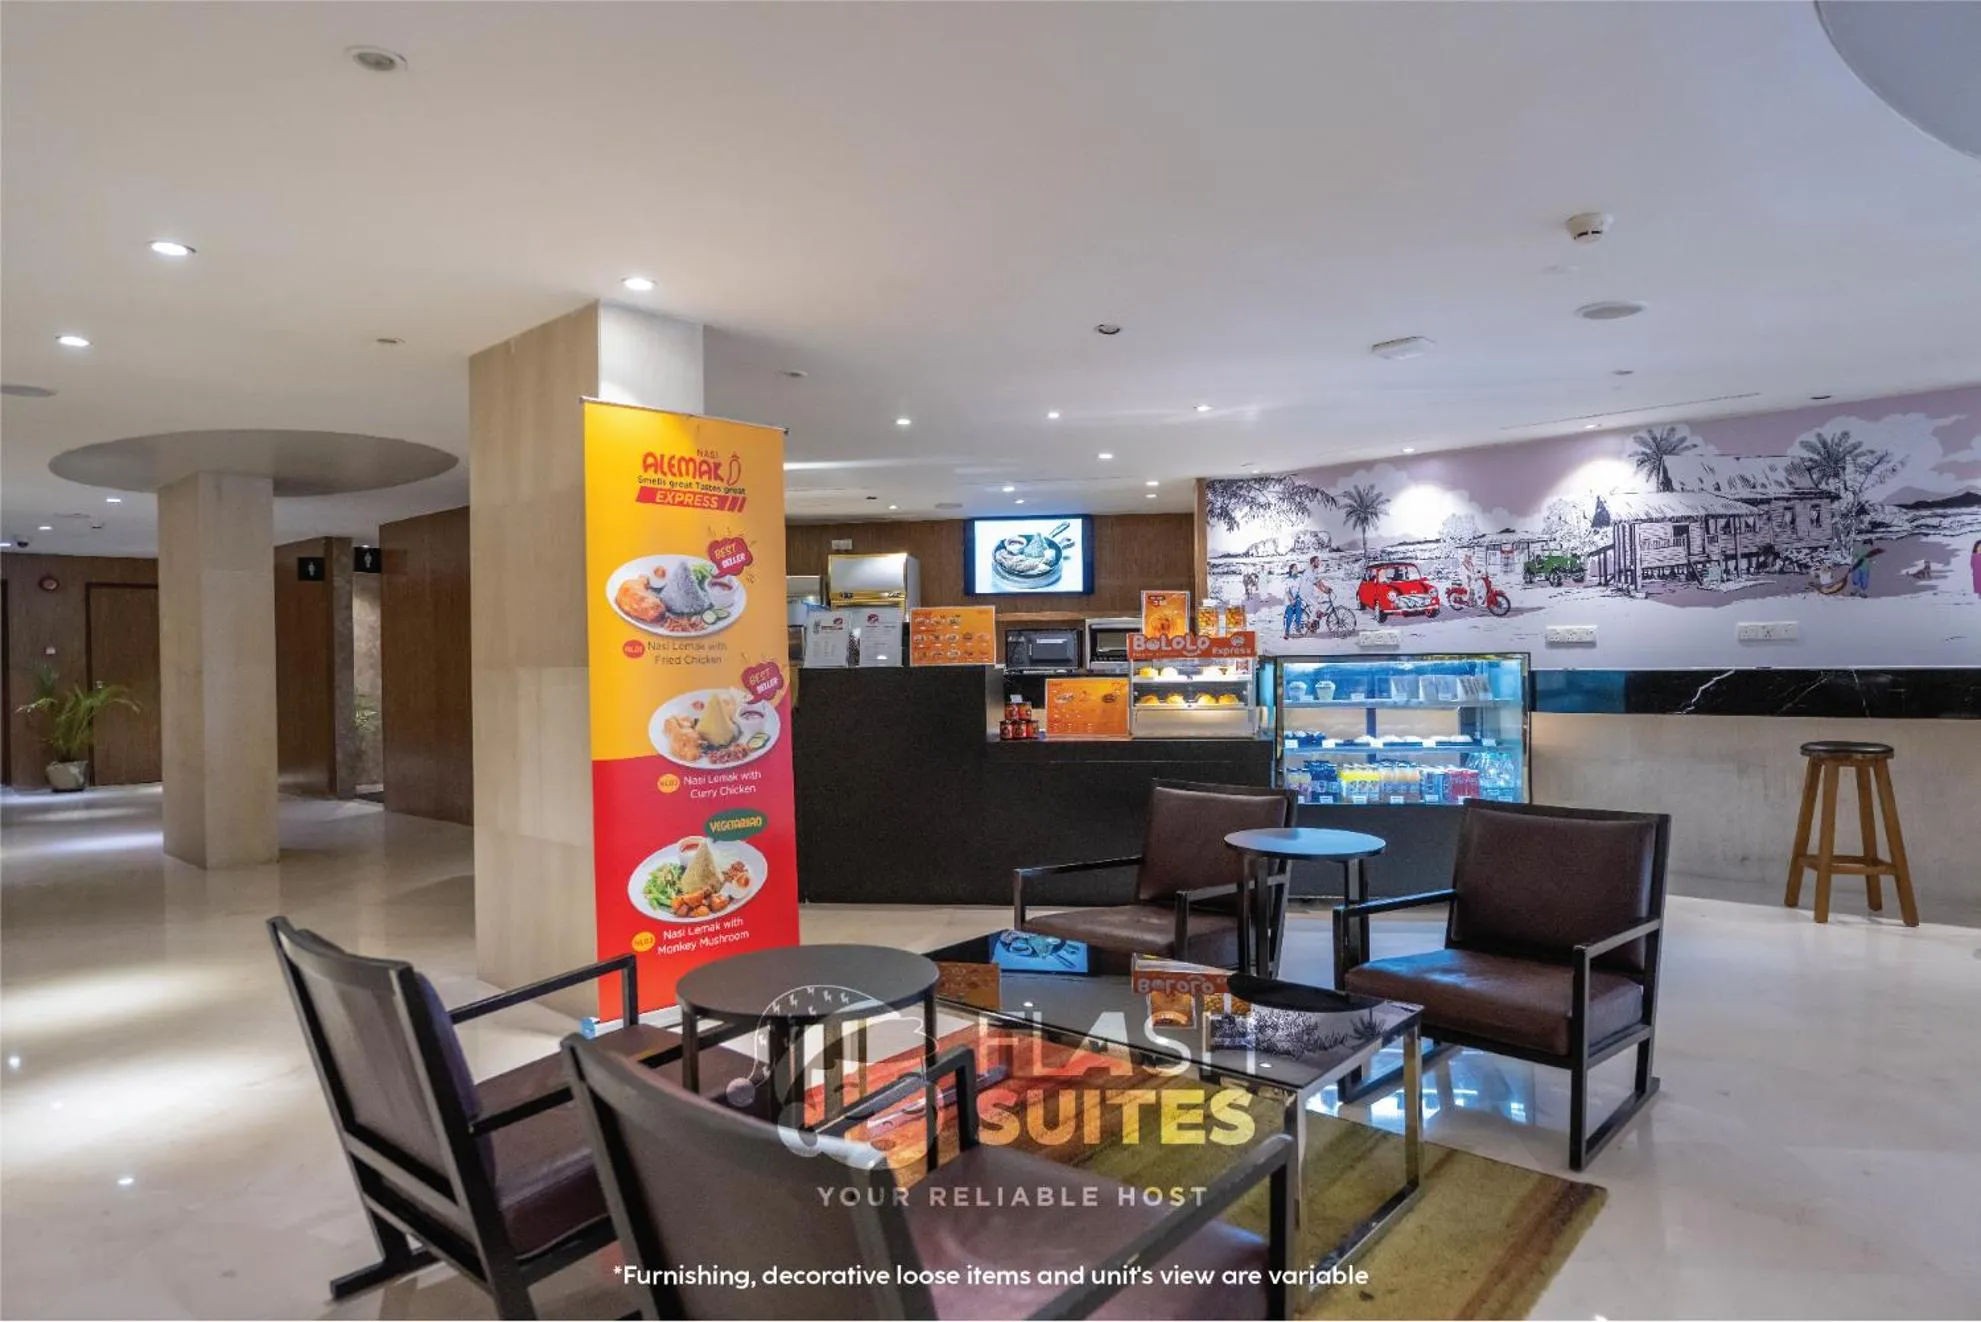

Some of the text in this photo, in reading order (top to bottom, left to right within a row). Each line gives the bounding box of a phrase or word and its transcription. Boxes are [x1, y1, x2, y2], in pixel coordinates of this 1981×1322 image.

[697, 448, 719, 459] NASI
[642, 451, 724, 482] ALEMAK
[638, 475, 746, 495] Smells great Tastes great
[656, 490, 719, 508] EXPRESS
[714, 543, 737, 559] BEST
[648, 641, 727, 651] Nasi Lemak with
[1212, 646, 1251, 657] Express
[655, 655, 722, 665] Fried Chicken
[750, 668, 771, 686] BEST
[683, 770, 762, 786] Nasi Lemak with
[690, 785, 757, 799] Curry Chicken
[709, 816, 762, 833] VEGETARIAN
[663, 917, 744, 940] Nasi Lemak with
[657, 931, 750, 955] Monkey Mushroom
